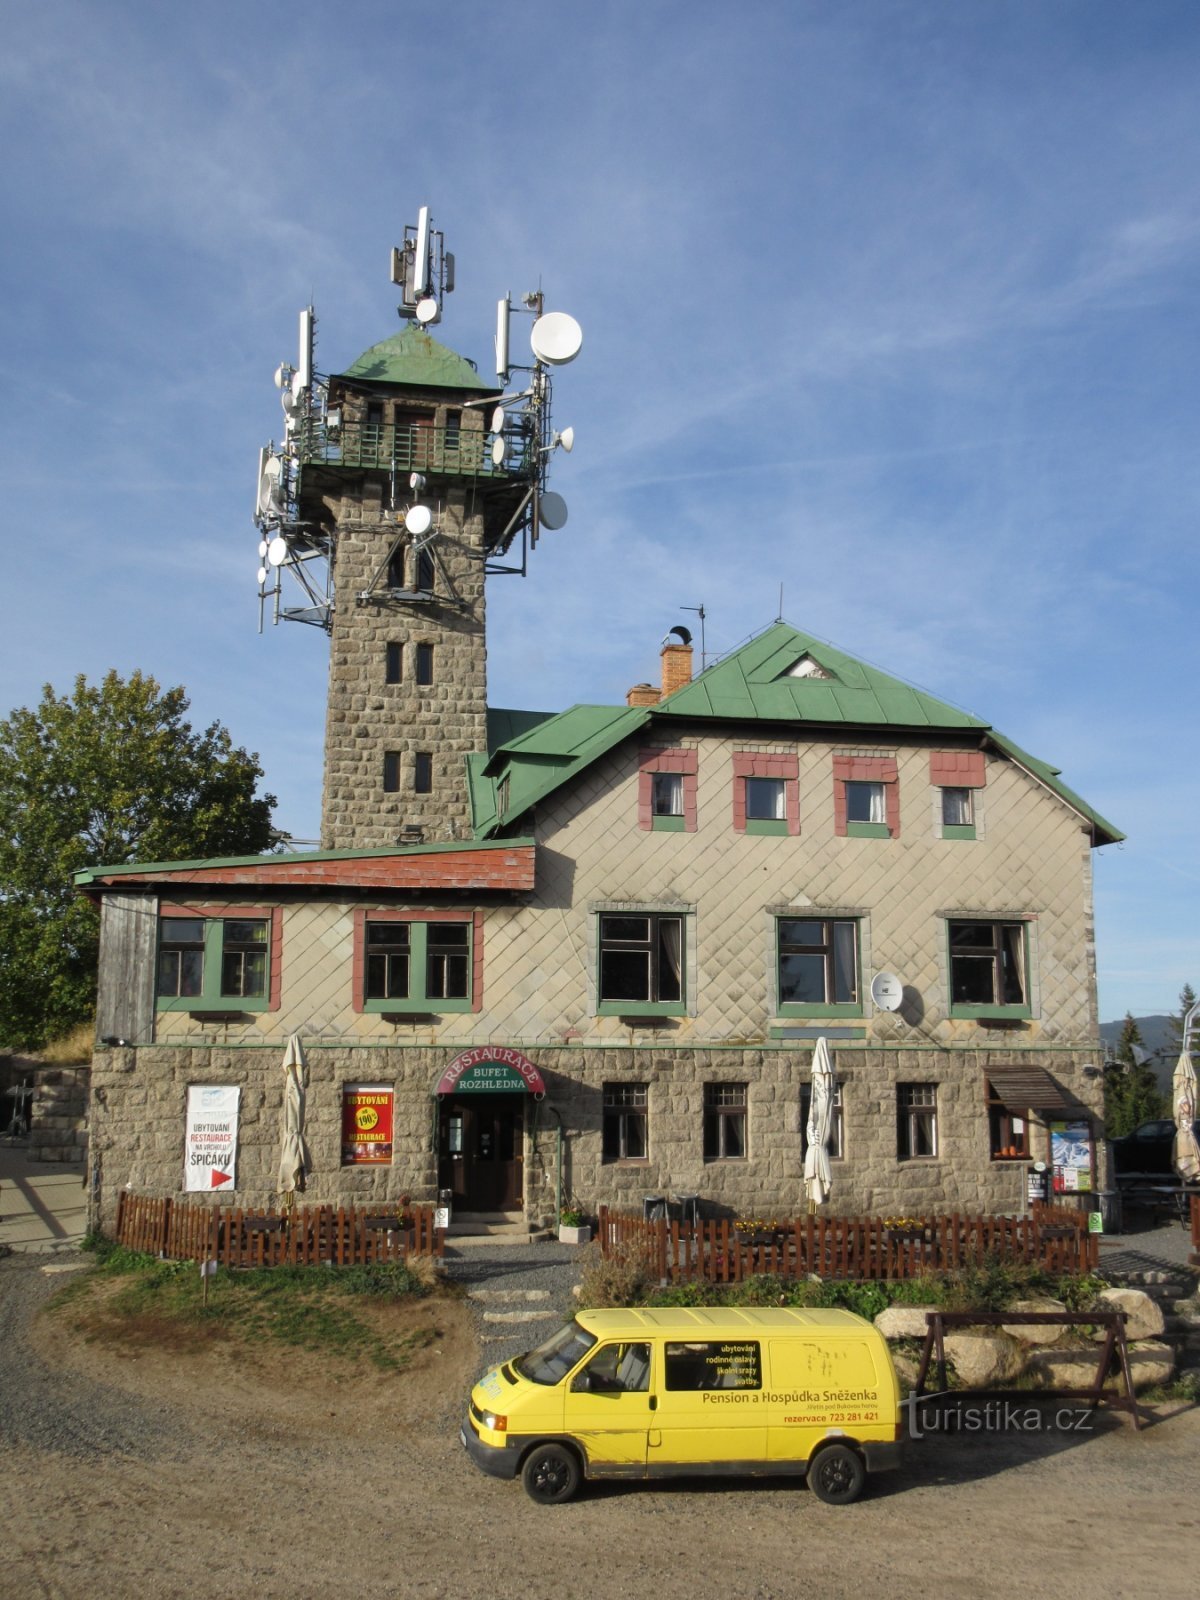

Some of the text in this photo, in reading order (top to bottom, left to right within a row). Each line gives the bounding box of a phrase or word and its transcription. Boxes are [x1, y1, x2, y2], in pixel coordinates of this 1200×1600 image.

[445, 1047, 539, 1084] RESTAURACE
[473, 1068, 509, 1077] BUFET
[459, 1080, 526, 1089] ROZHLEDNA
[347, 1094, 389, 1105] UBYTOVÁNÍ
[193, 1122, 230, 1132] UBYTOVÁNÍ
[190, 1133, 232, 1142] RESTAURACE
[349, 1133, 386, 1141] RESTAURACE
[195, 1143, 203, 1151] NA
[190, 1151, 230, 1166] ŠPIČÁKU
[721, 1344, 756, 1354] ubytování
[705, 1355, 757, 1365] rodinné oslavy
[716, 1366, 738, 1375] školní
[702, 1389, 878, 1405] Pension a Hospůdka Sněženka
[784, 1412, 879, 1423] rezervace 723 281 421
